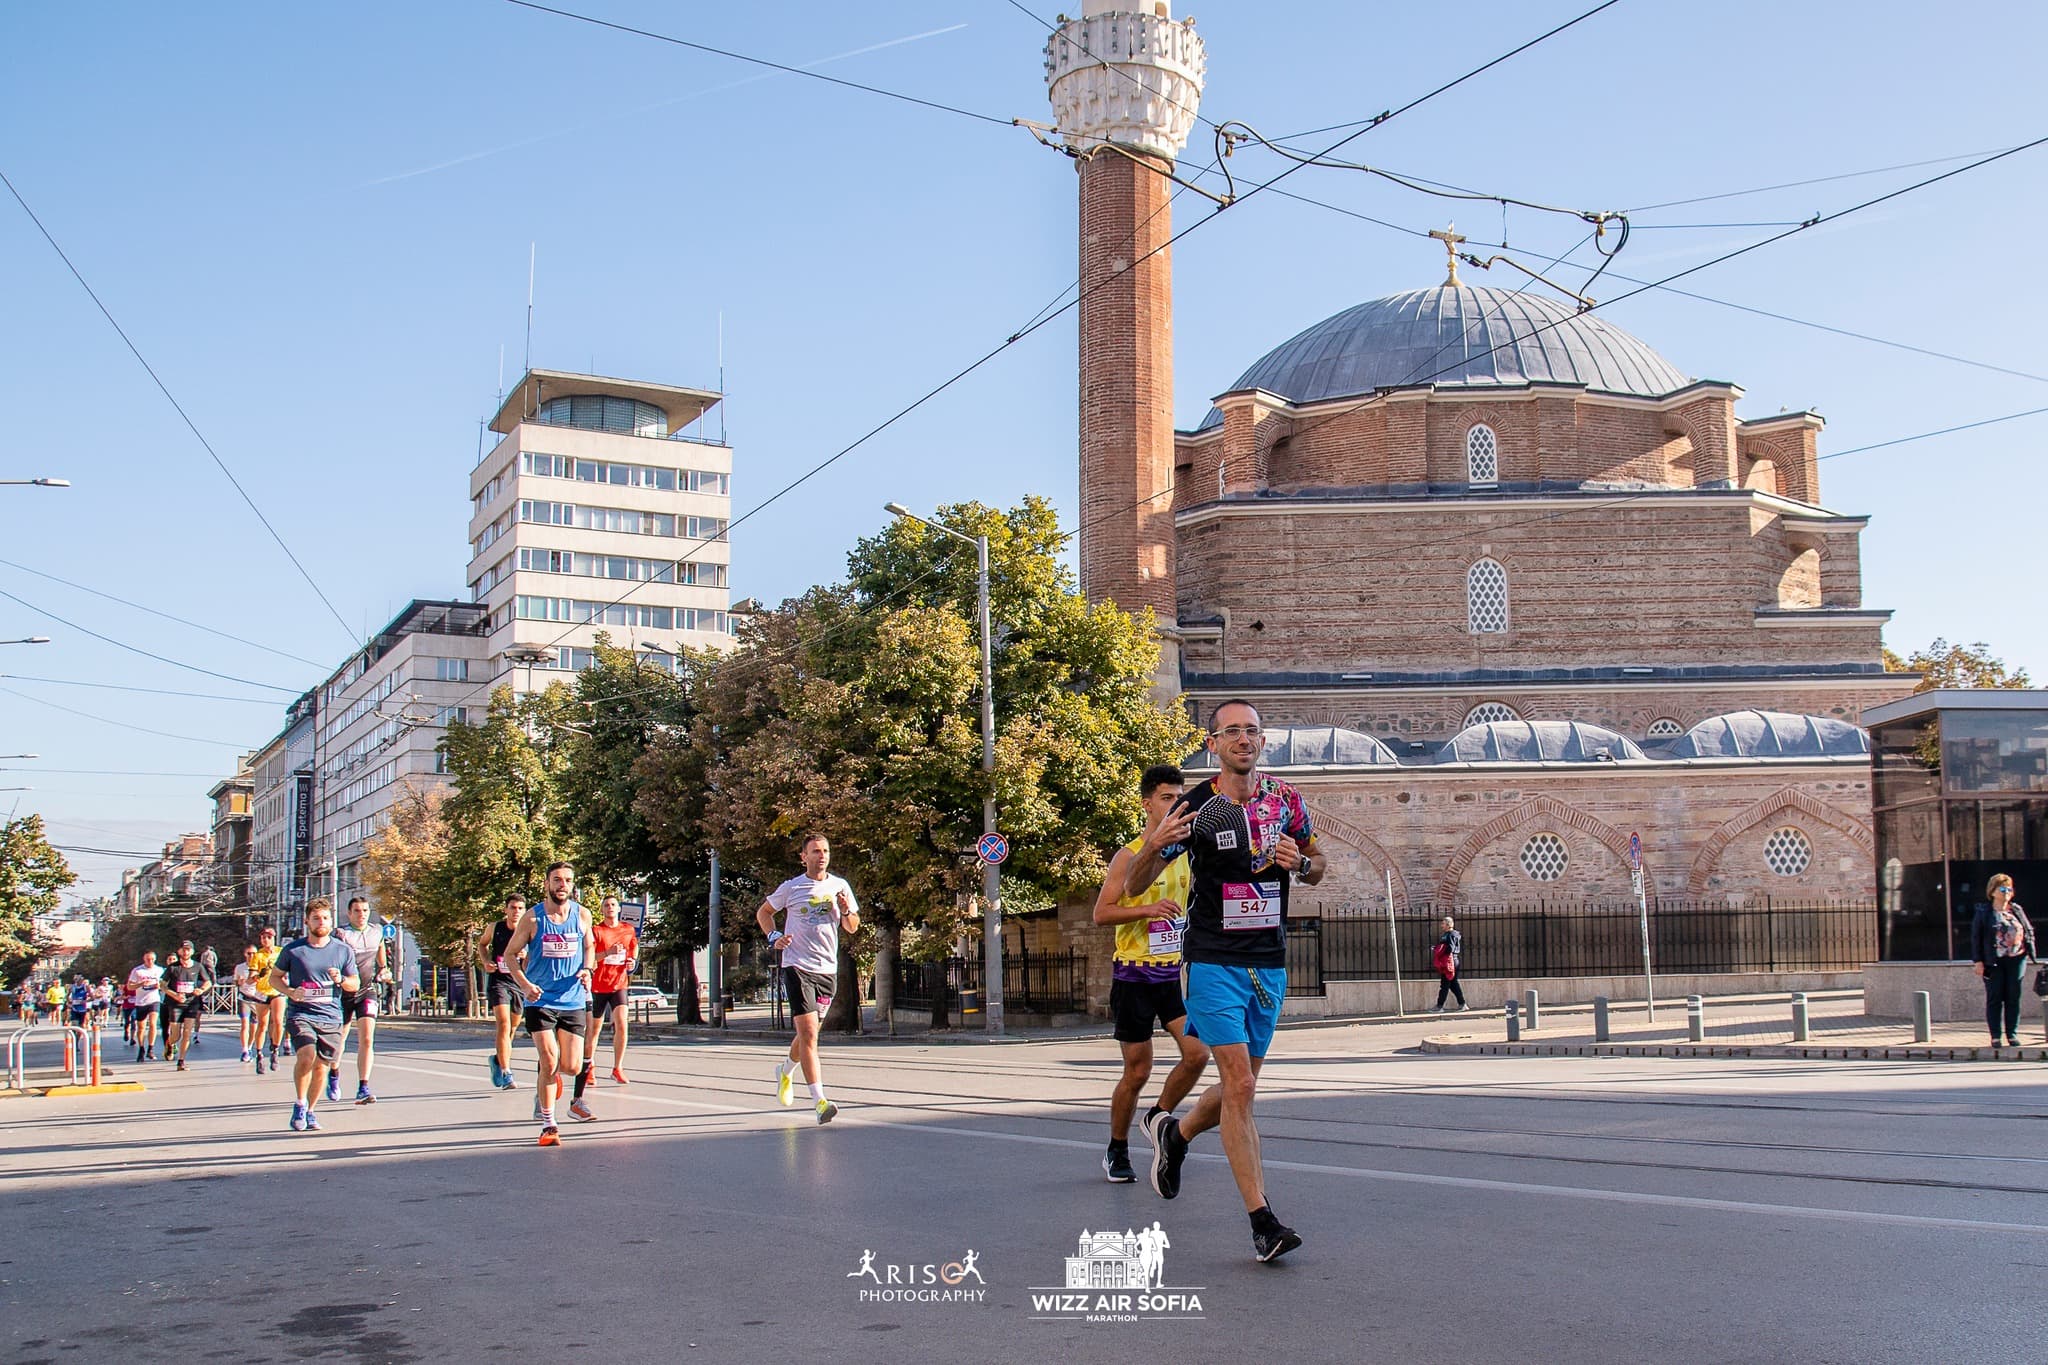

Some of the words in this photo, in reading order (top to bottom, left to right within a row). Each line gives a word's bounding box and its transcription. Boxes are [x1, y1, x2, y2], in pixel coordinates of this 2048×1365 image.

[1240, 900, 1268, 913] 547
[1161, 931, 1179, 943] 556
[553, 942, 569, 950] 193
